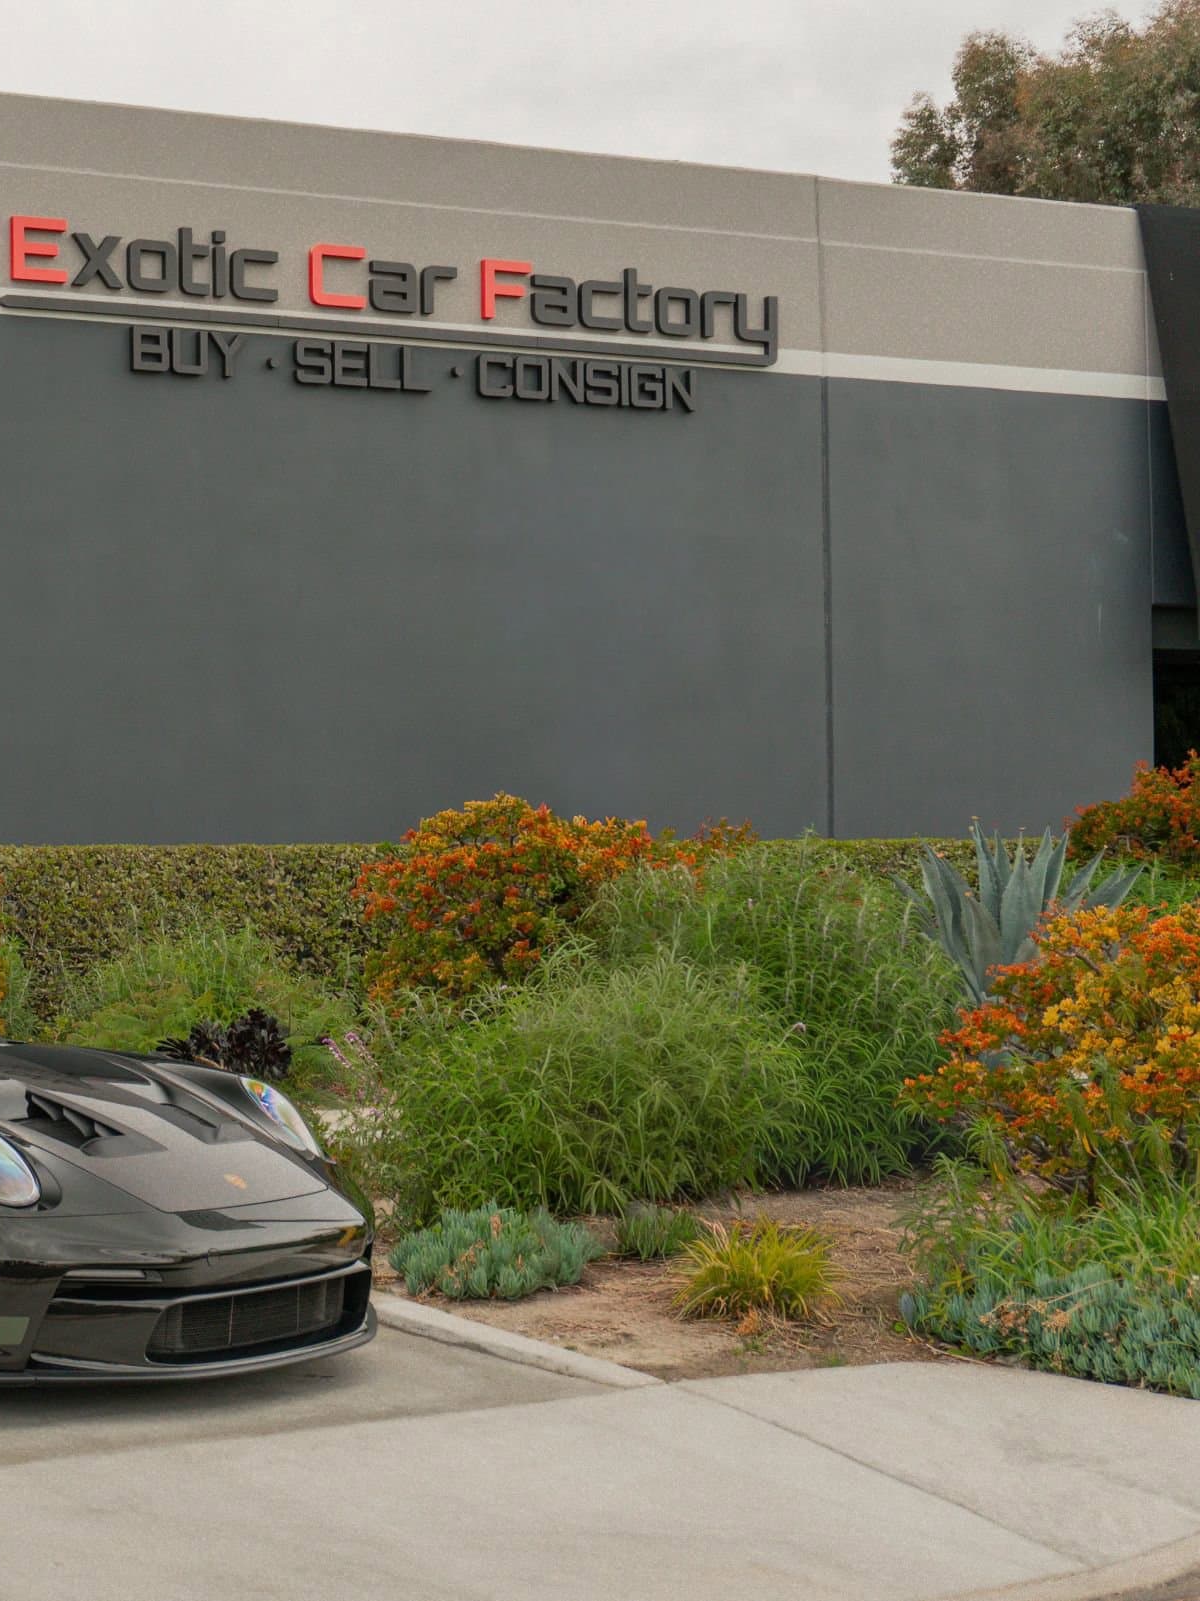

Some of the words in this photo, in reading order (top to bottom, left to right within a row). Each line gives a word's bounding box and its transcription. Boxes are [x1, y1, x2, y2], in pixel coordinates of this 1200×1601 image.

[10, 215, 279, 302] Exotic
[309, 243, 458, 315] Car
[480, 258, 779, 367] Factory
[130, 325, 246, 379] BUY
[294, 339, 432, 393] SELL
[477, 353, 696, 412] CONSIGN
